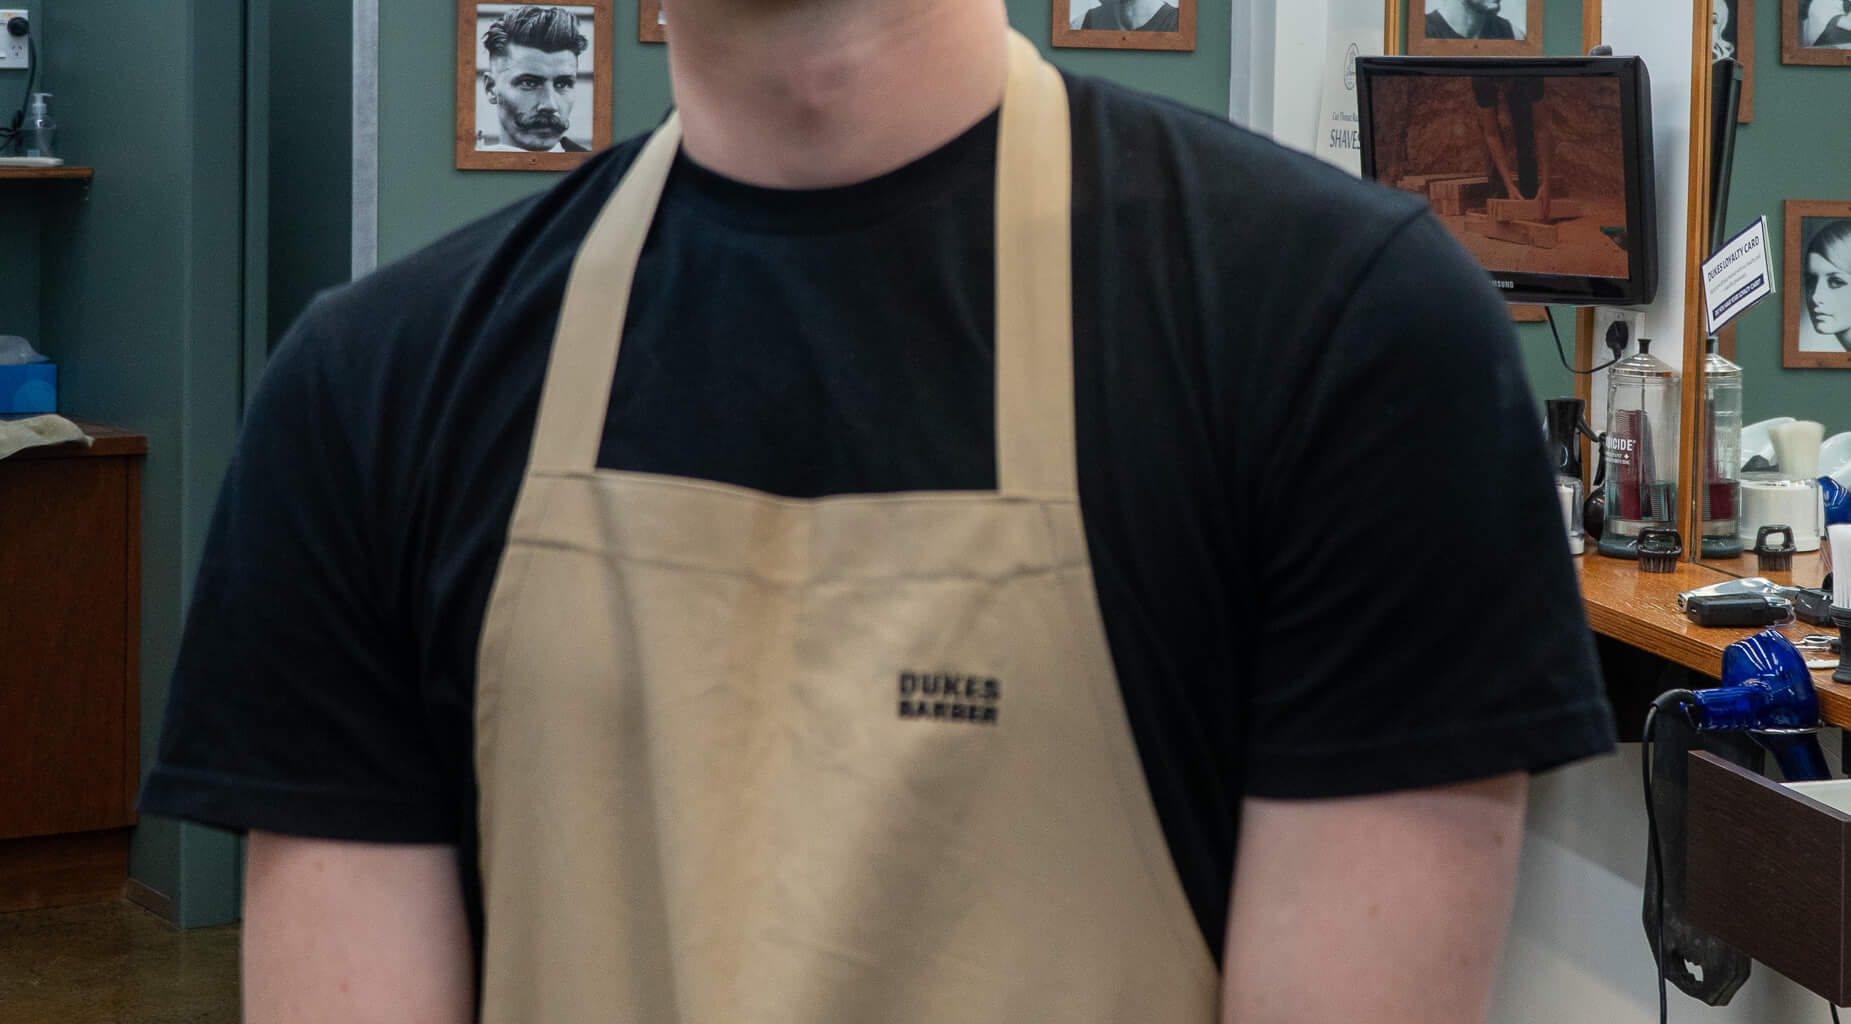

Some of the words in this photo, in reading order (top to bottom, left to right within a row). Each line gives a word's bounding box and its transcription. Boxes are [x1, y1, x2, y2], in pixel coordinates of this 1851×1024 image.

[1708, 263, 1722, 282] DUKES
[1723, 247, 1744, 269] LOYALTY
[1744, 236, 1759, 253] CARD
[898, 671, 1001, 699] DUKES
